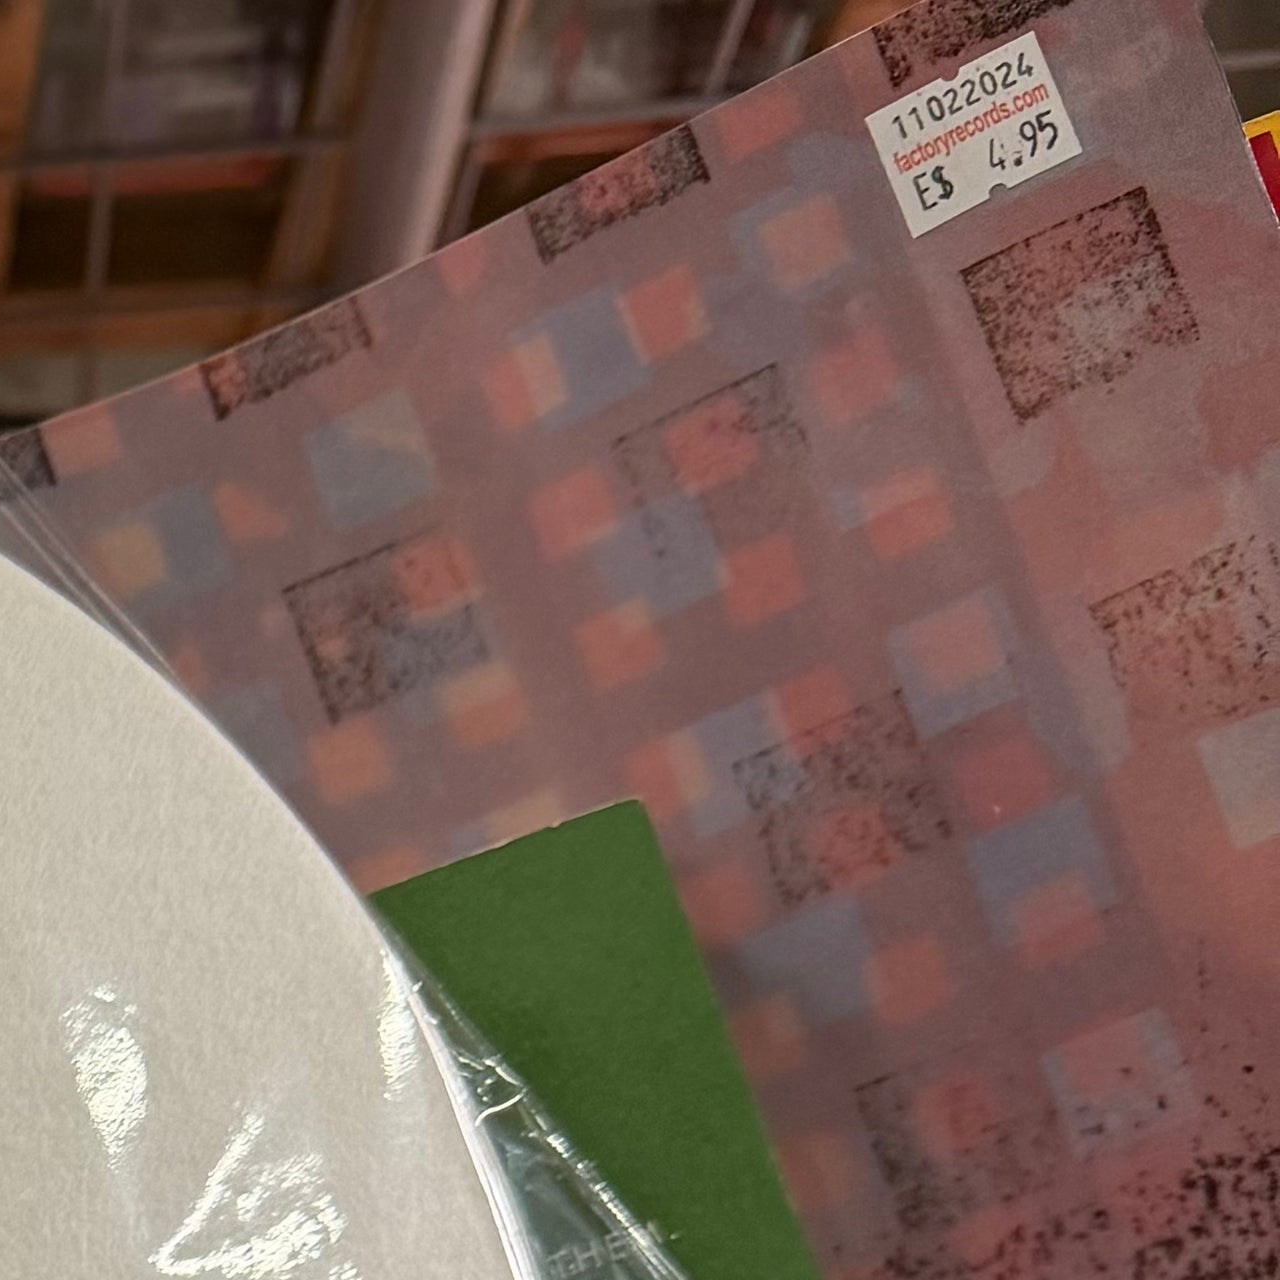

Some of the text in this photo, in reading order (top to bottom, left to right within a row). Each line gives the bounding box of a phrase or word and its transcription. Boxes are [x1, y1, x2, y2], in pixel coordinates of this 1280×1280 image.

[892, 52, 1035, 140] 11022024
[893, 81, 1050, 175] factoryrecords.com
[988, 109, 1059, 172] 4.95
